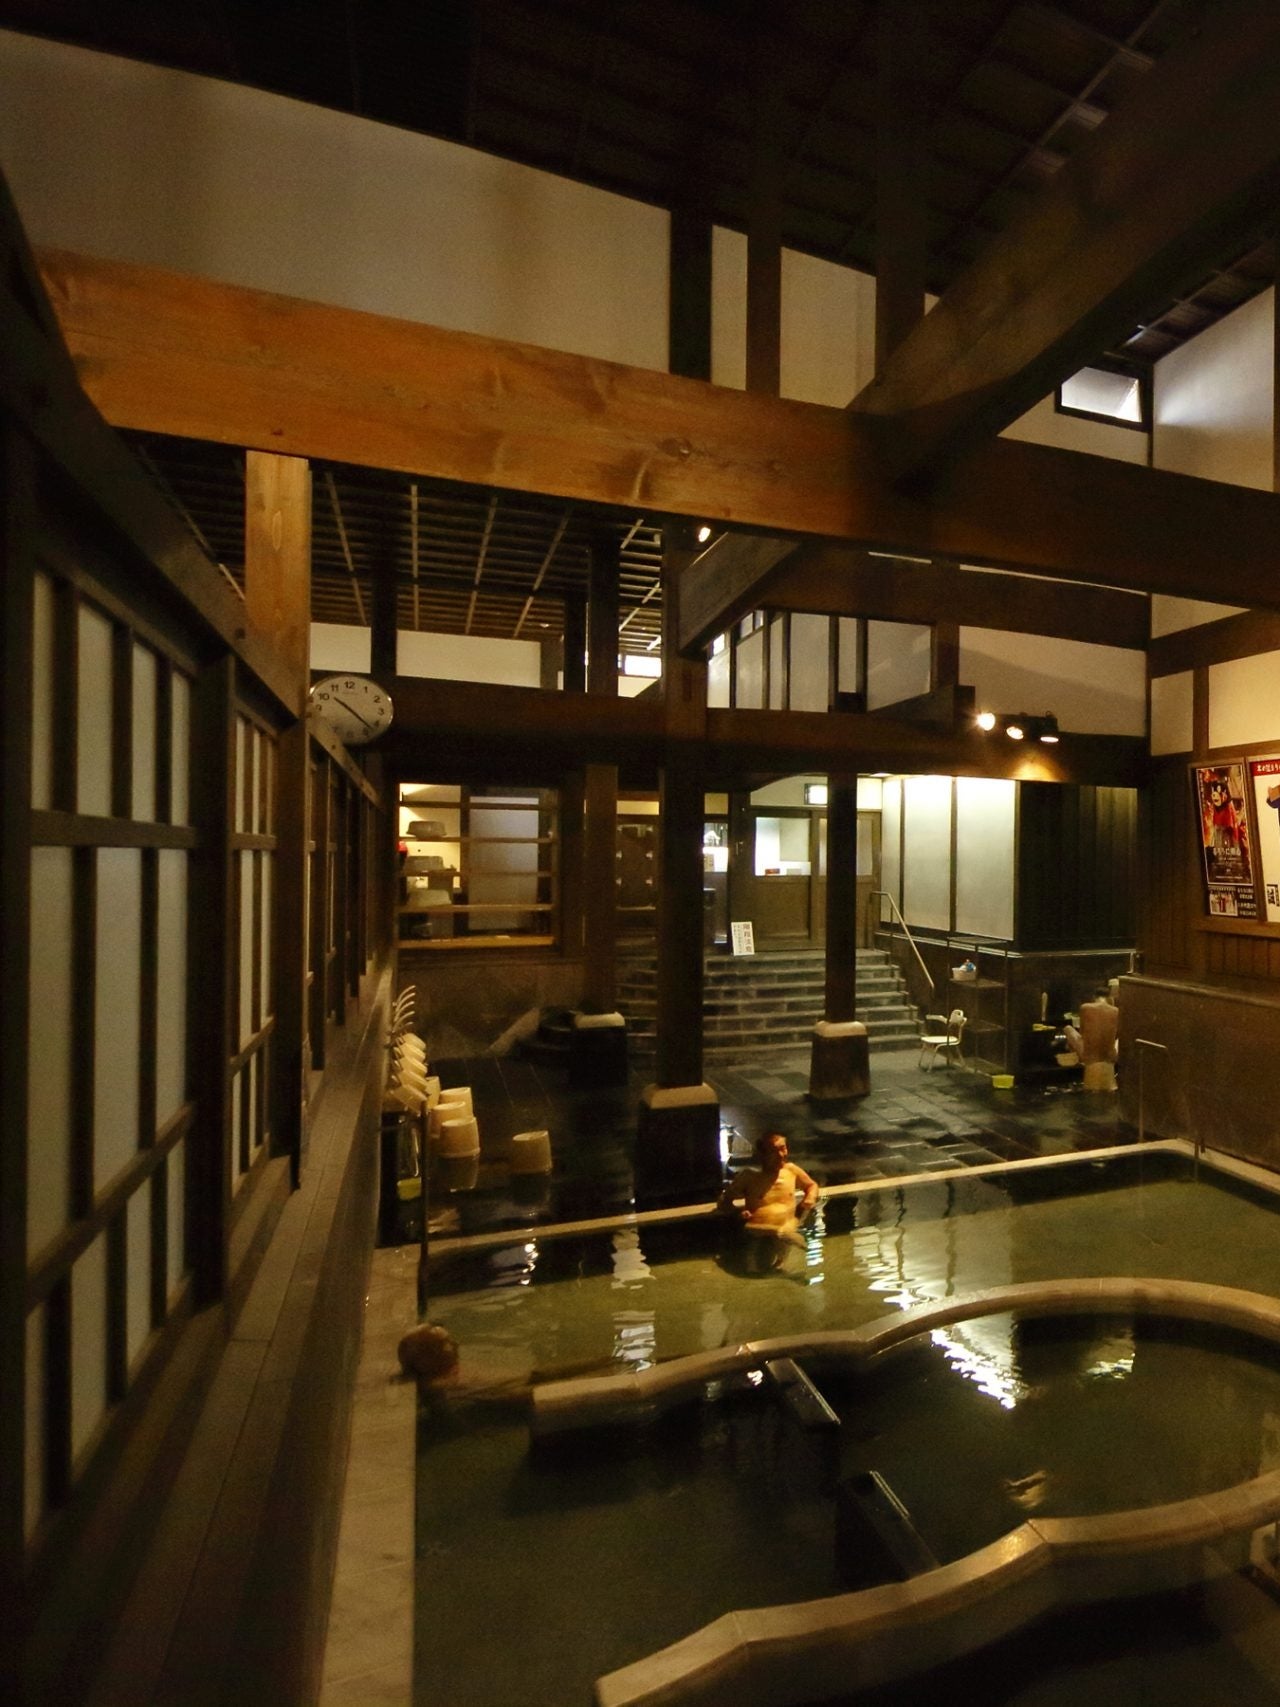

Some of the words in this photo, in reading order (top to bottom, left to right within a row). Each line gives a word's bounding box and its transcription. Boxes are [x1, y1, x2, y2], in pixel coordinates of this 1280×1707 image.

[331, 684, 339, 692] 11
[344, 681, 355, 689] 12
[319, 693, 330, 701] 10
[374, 695, 381, 703] 2
[378, 708, 385, 716] 3
